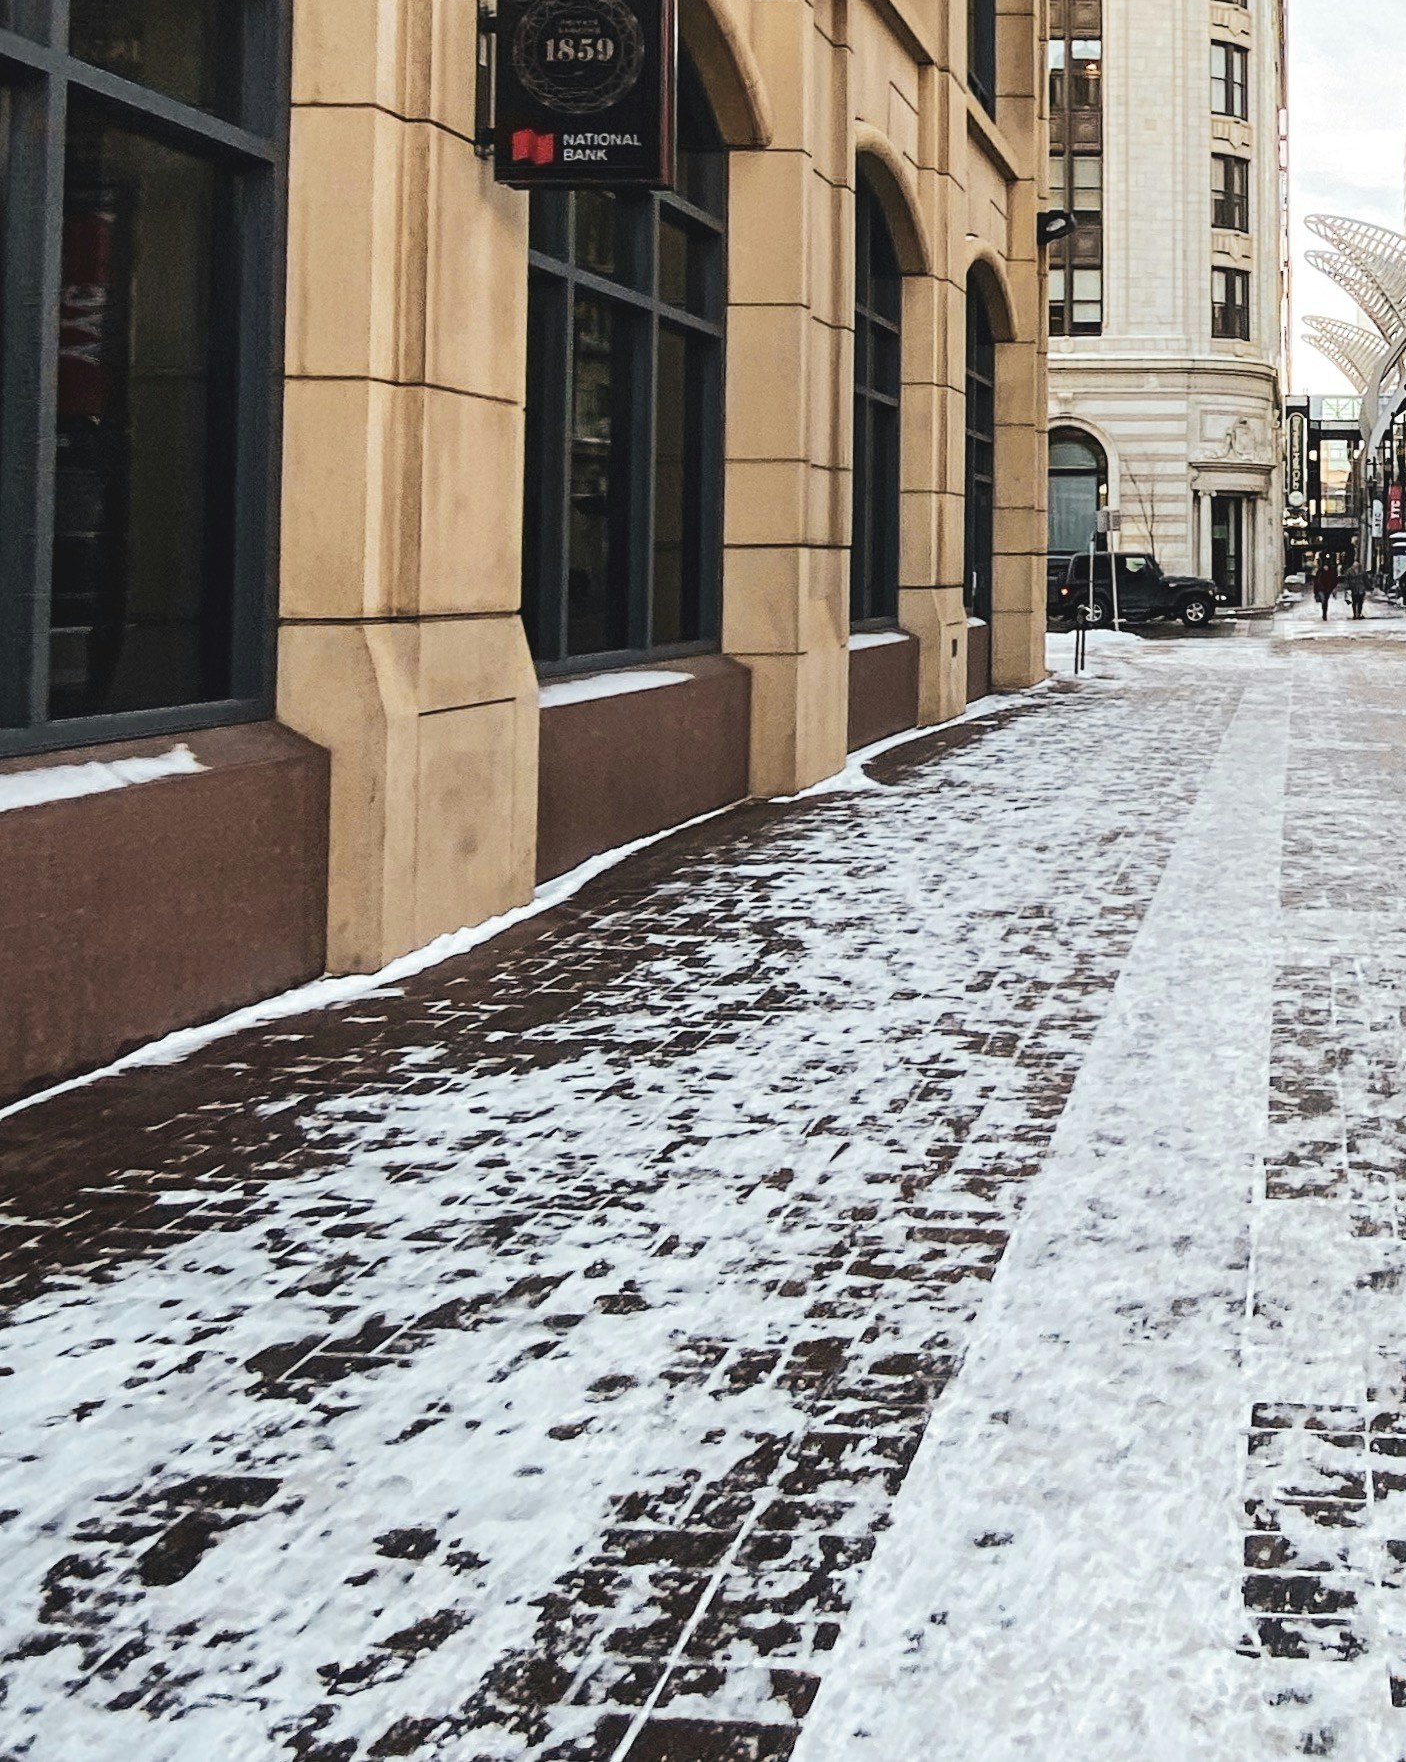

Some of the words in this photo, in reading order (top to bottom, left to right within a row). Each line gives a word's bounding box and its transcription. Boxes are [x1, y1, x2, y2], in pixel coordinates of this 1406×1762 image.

[545, 38, 615, 62] 1859
[562, 132, 642, 147] NATIONAL
[562, 148, 608, 162] BANK
